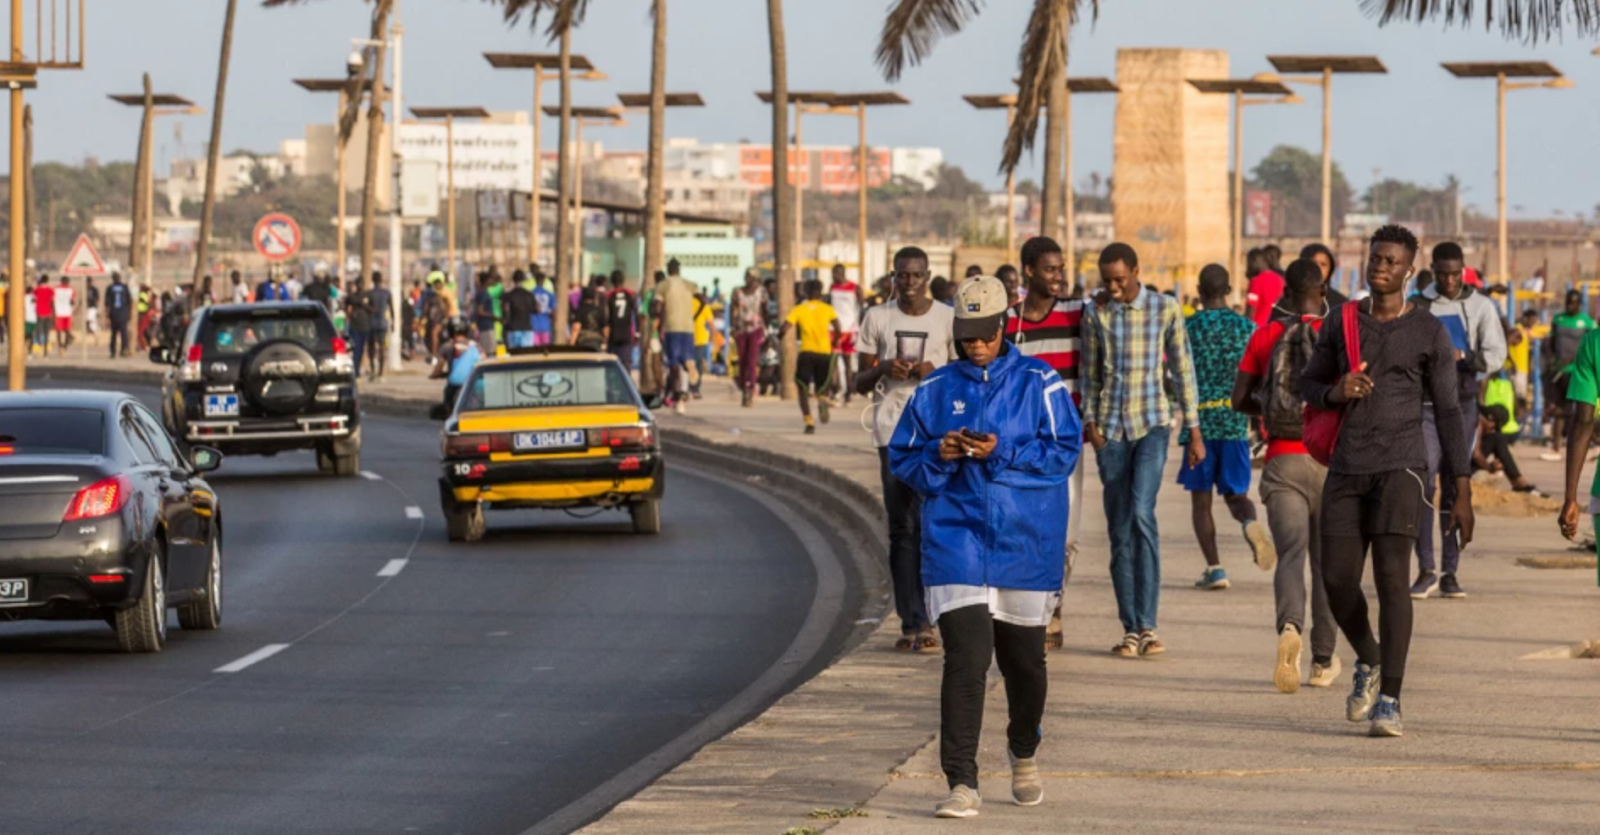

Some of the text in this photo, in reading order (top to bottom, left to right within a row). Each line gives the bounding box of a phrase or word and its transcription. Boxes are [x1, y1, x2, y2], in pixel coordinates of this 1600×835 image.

[615, 299, 626, 318] 7
[454, 463, 470, 475] 10
[0, 582, 24, 596] 3P
